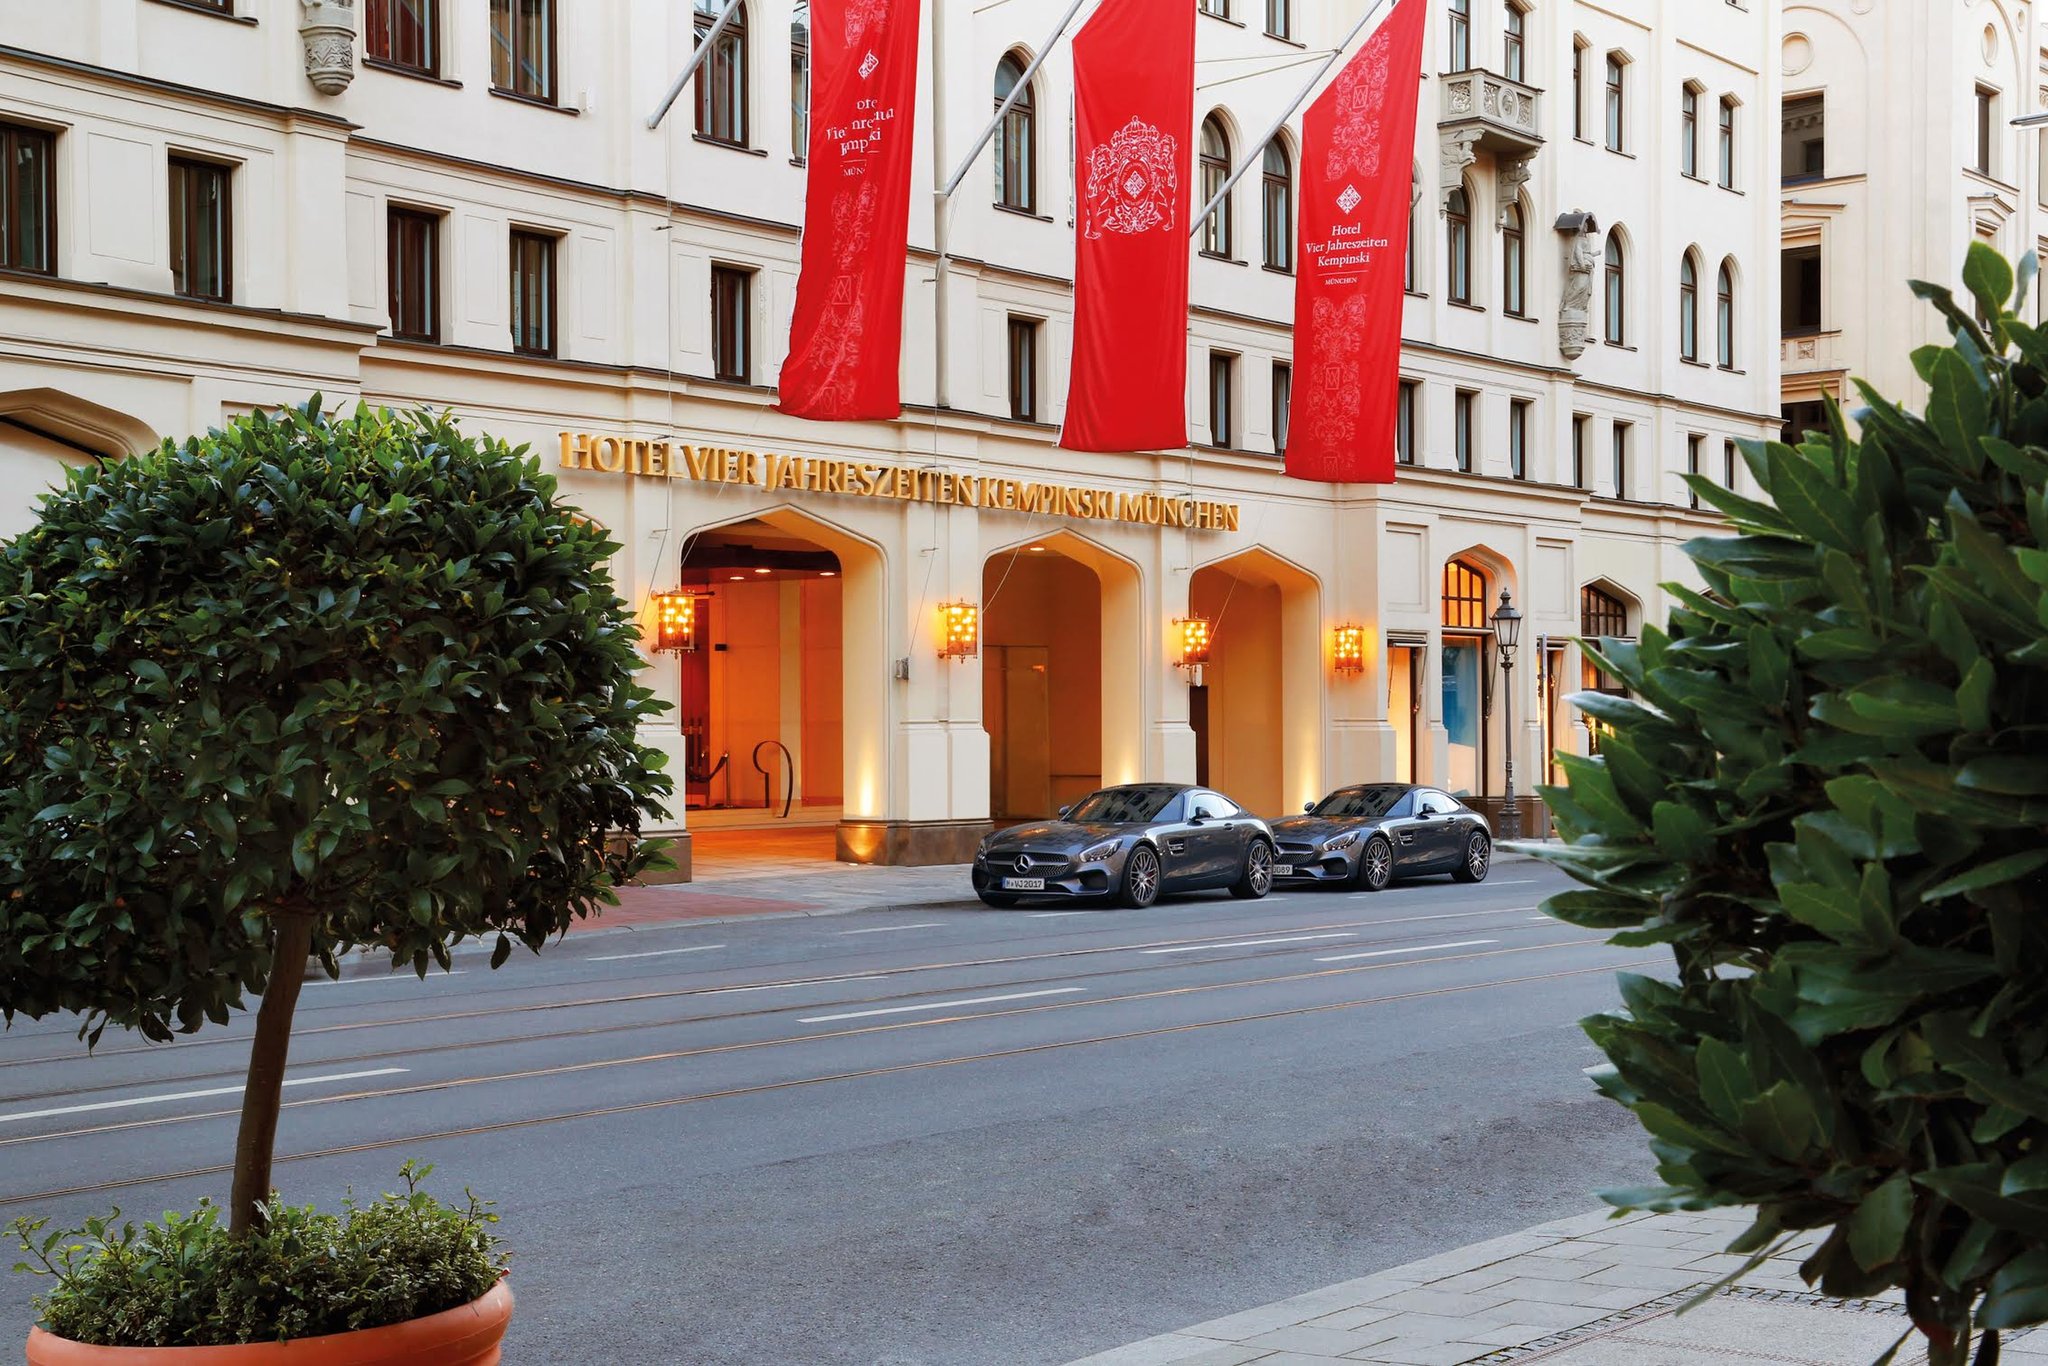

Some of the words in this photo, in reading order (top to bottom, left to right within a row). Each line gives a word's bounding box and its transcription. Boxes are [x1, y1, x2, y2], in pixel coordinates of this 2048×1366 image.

[1331, 222, 1361, 236] Hotel
[1305, 242, 1325, 253] Vier
[1325, 236, 1388, 254] Jahreszeiten
[1317, 252, 1370, 267] Kempinski
[1325, 276, 1358, 285] MÜNCHEN
[558, 431, 686, 478] HOTEL
[680, 444, 759, 485] VIER
[761, 453, 978, 507] JAHRESZEITEN
[977, 476, 1119, 521] KEMPINSKI
[1119, 491, 1241, 532] MÜNCHEN
